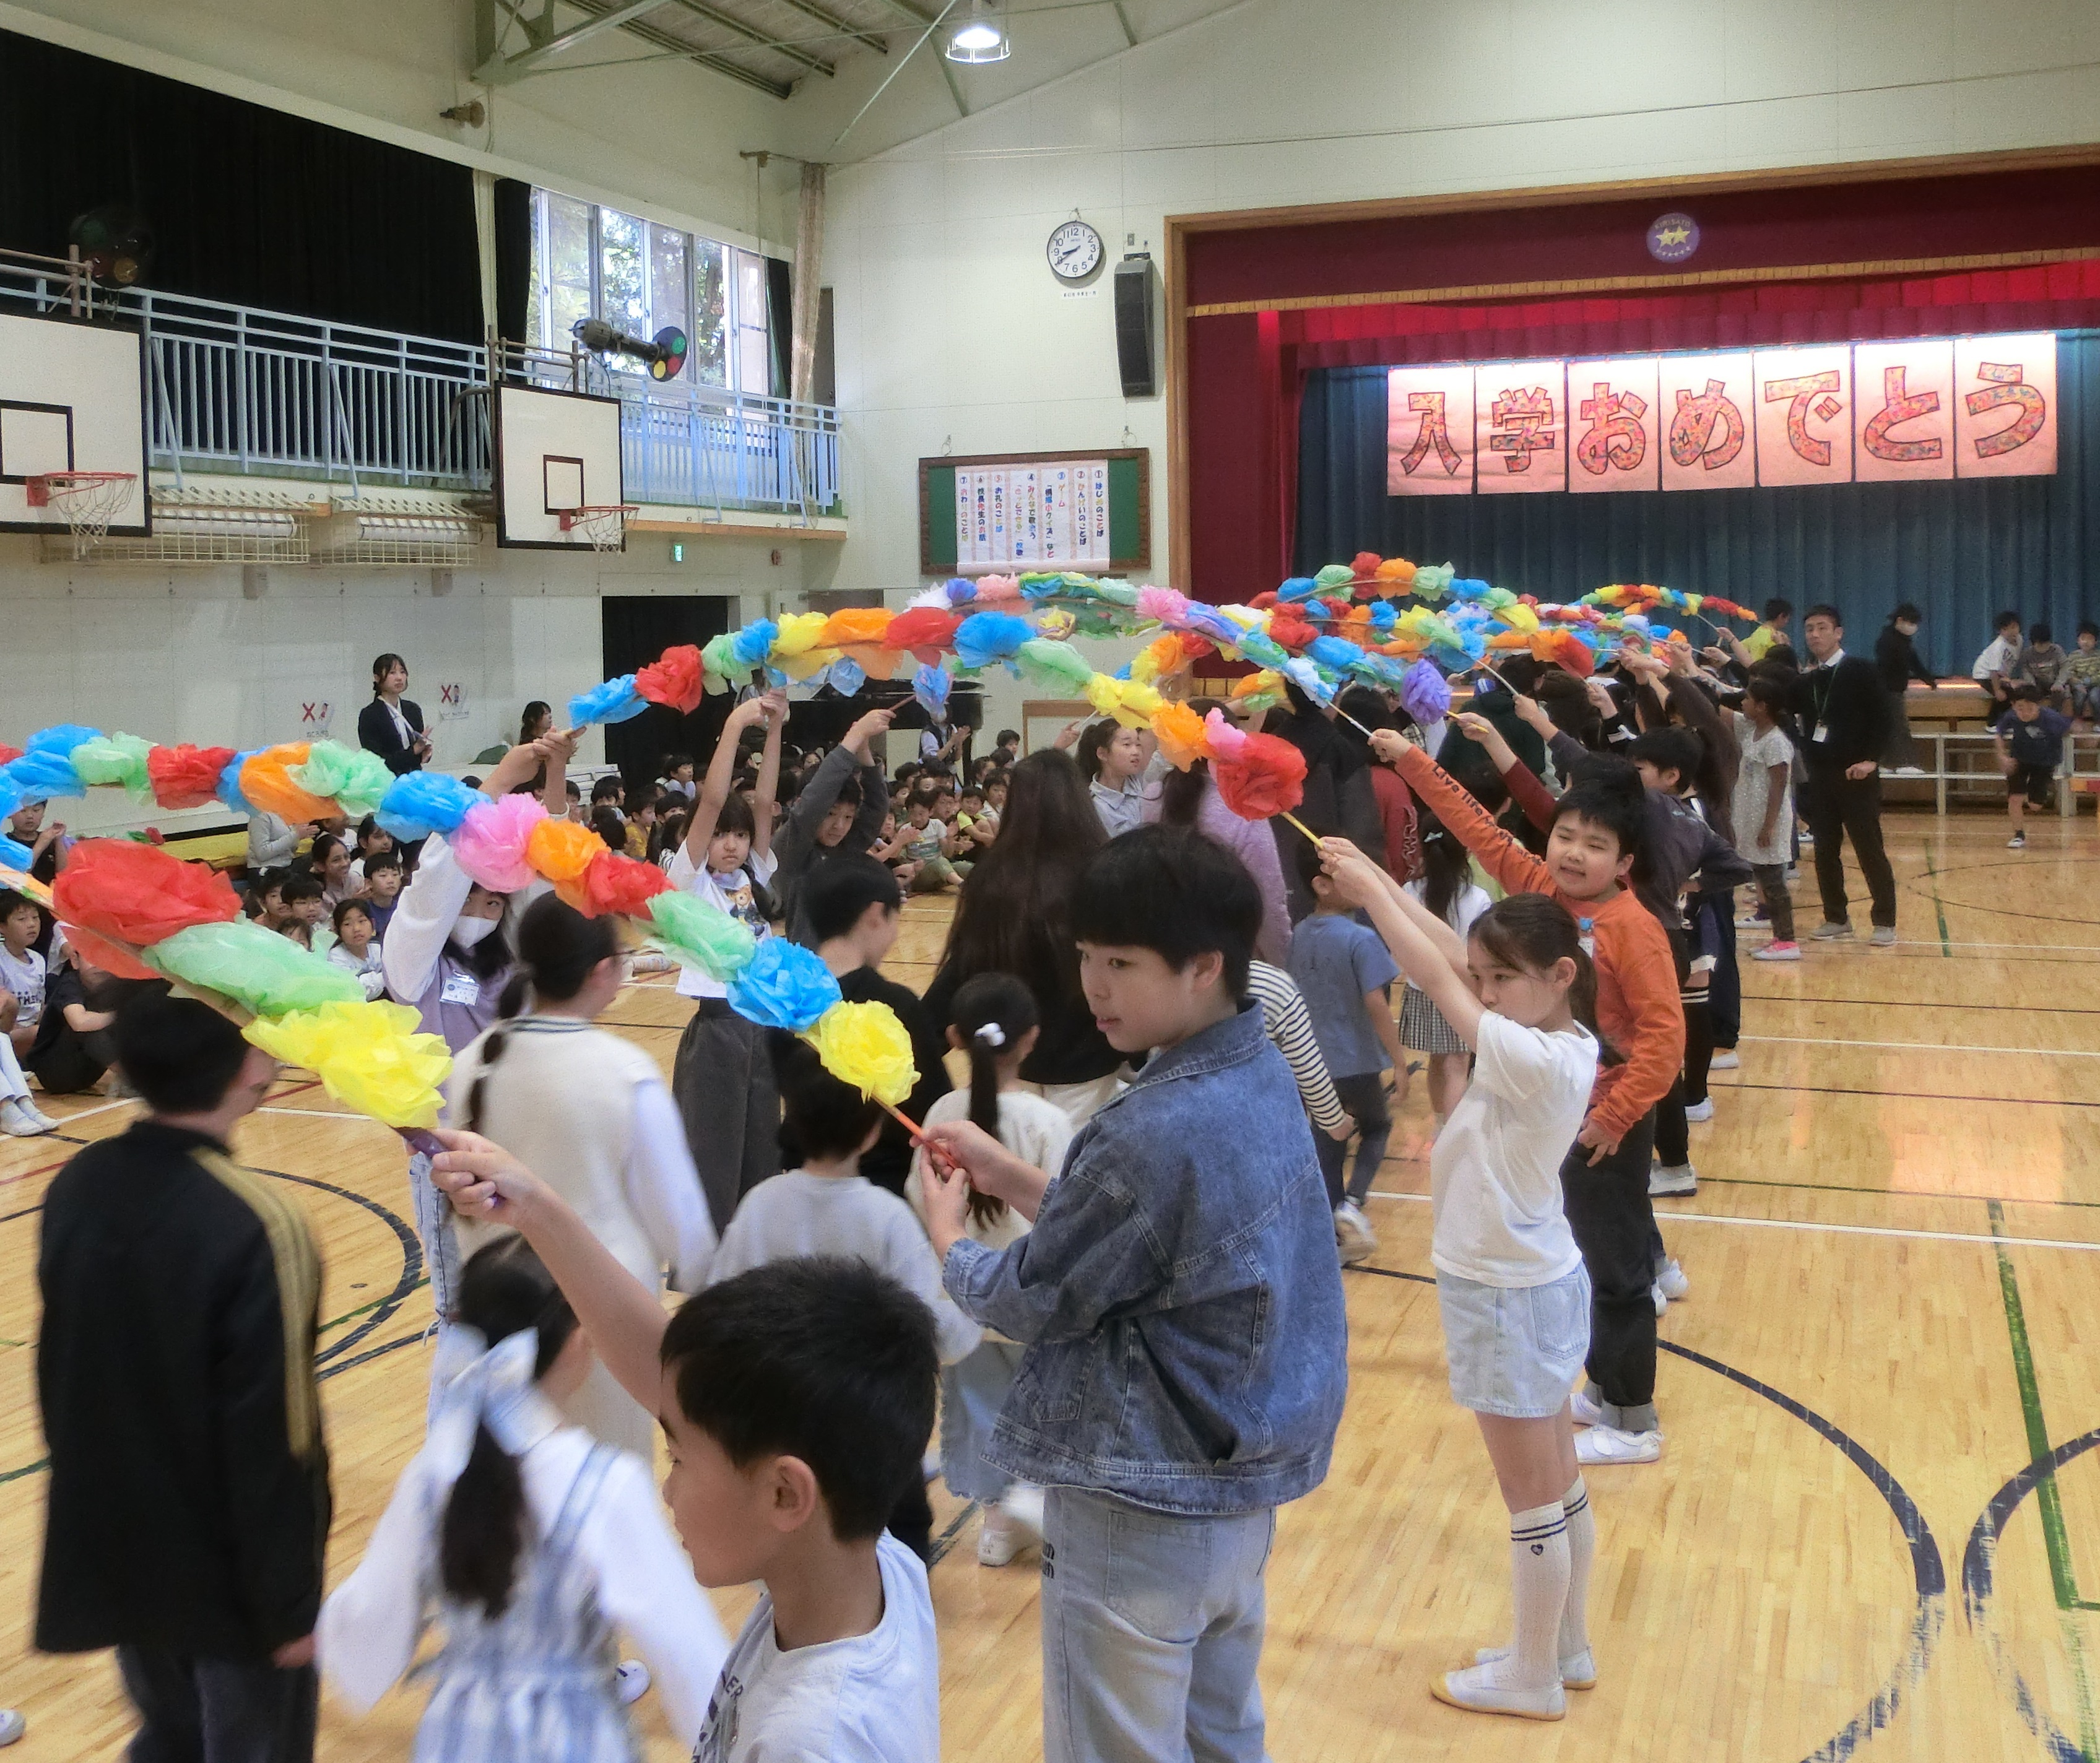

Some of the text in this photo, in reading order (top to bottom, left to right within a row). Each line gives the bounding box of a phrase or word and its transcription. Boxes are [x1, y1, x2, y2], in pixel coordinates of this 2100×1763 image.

[1063, 231, 1069, 239] 11
[1070, 228, 1078, 236] 12
[1054, 238, 1064, 246] 10
[1090, 245, 1096, 253] 3
[1072, 265, 1078, 273] 6
[1400, 362, 2047, 475] 入学おめでとう
